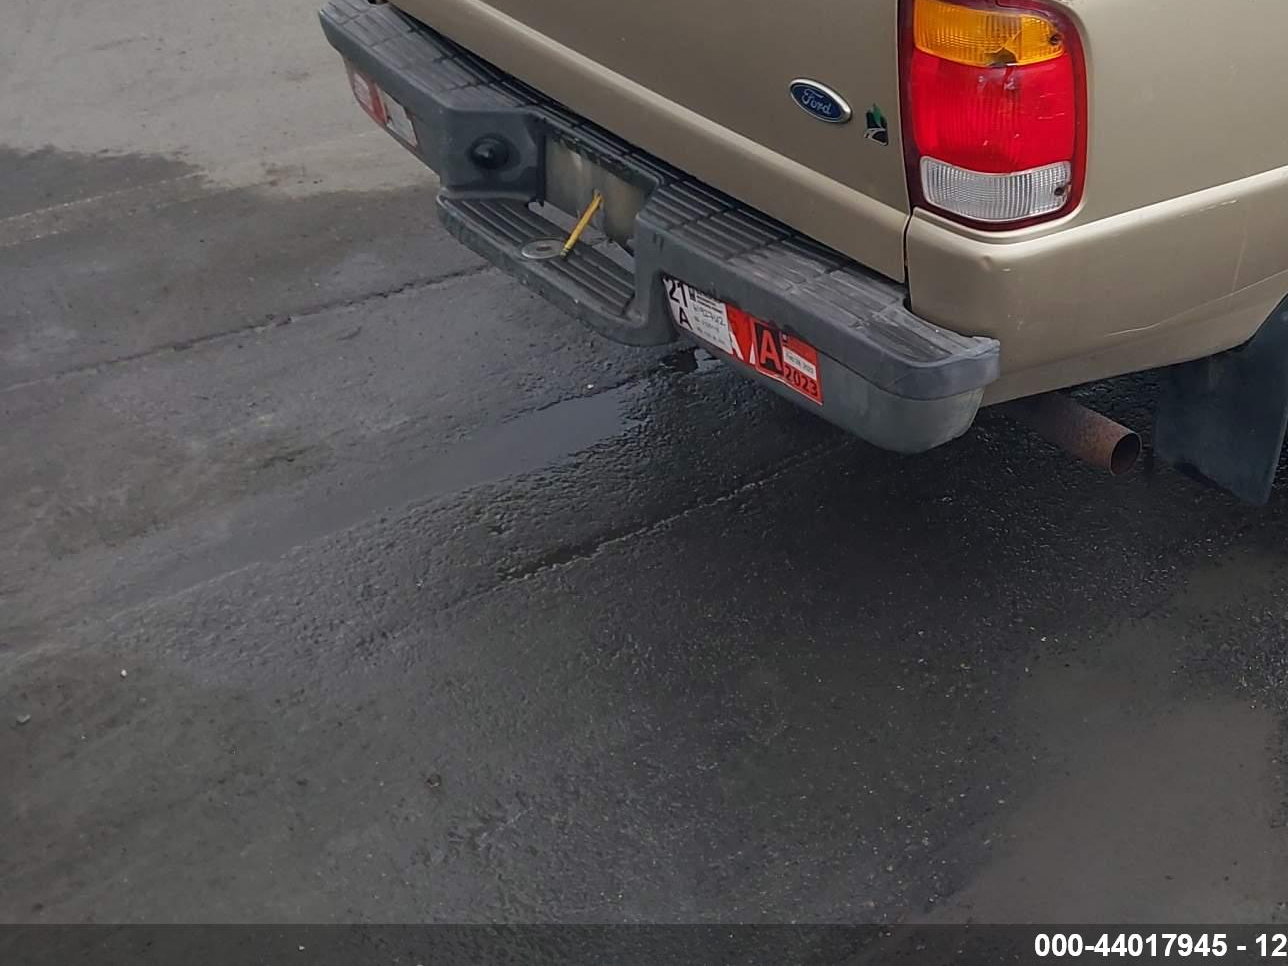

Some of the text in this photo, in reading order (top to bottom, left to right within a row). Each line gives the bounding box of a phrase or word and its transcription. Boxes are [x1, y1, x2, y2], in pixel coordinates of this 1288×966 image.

[802, 89, 832, 115] Ford
[678, 307, 694, 330] A
[759, 329, 783, 372] A
[784, 365, 818, 396] 2023
